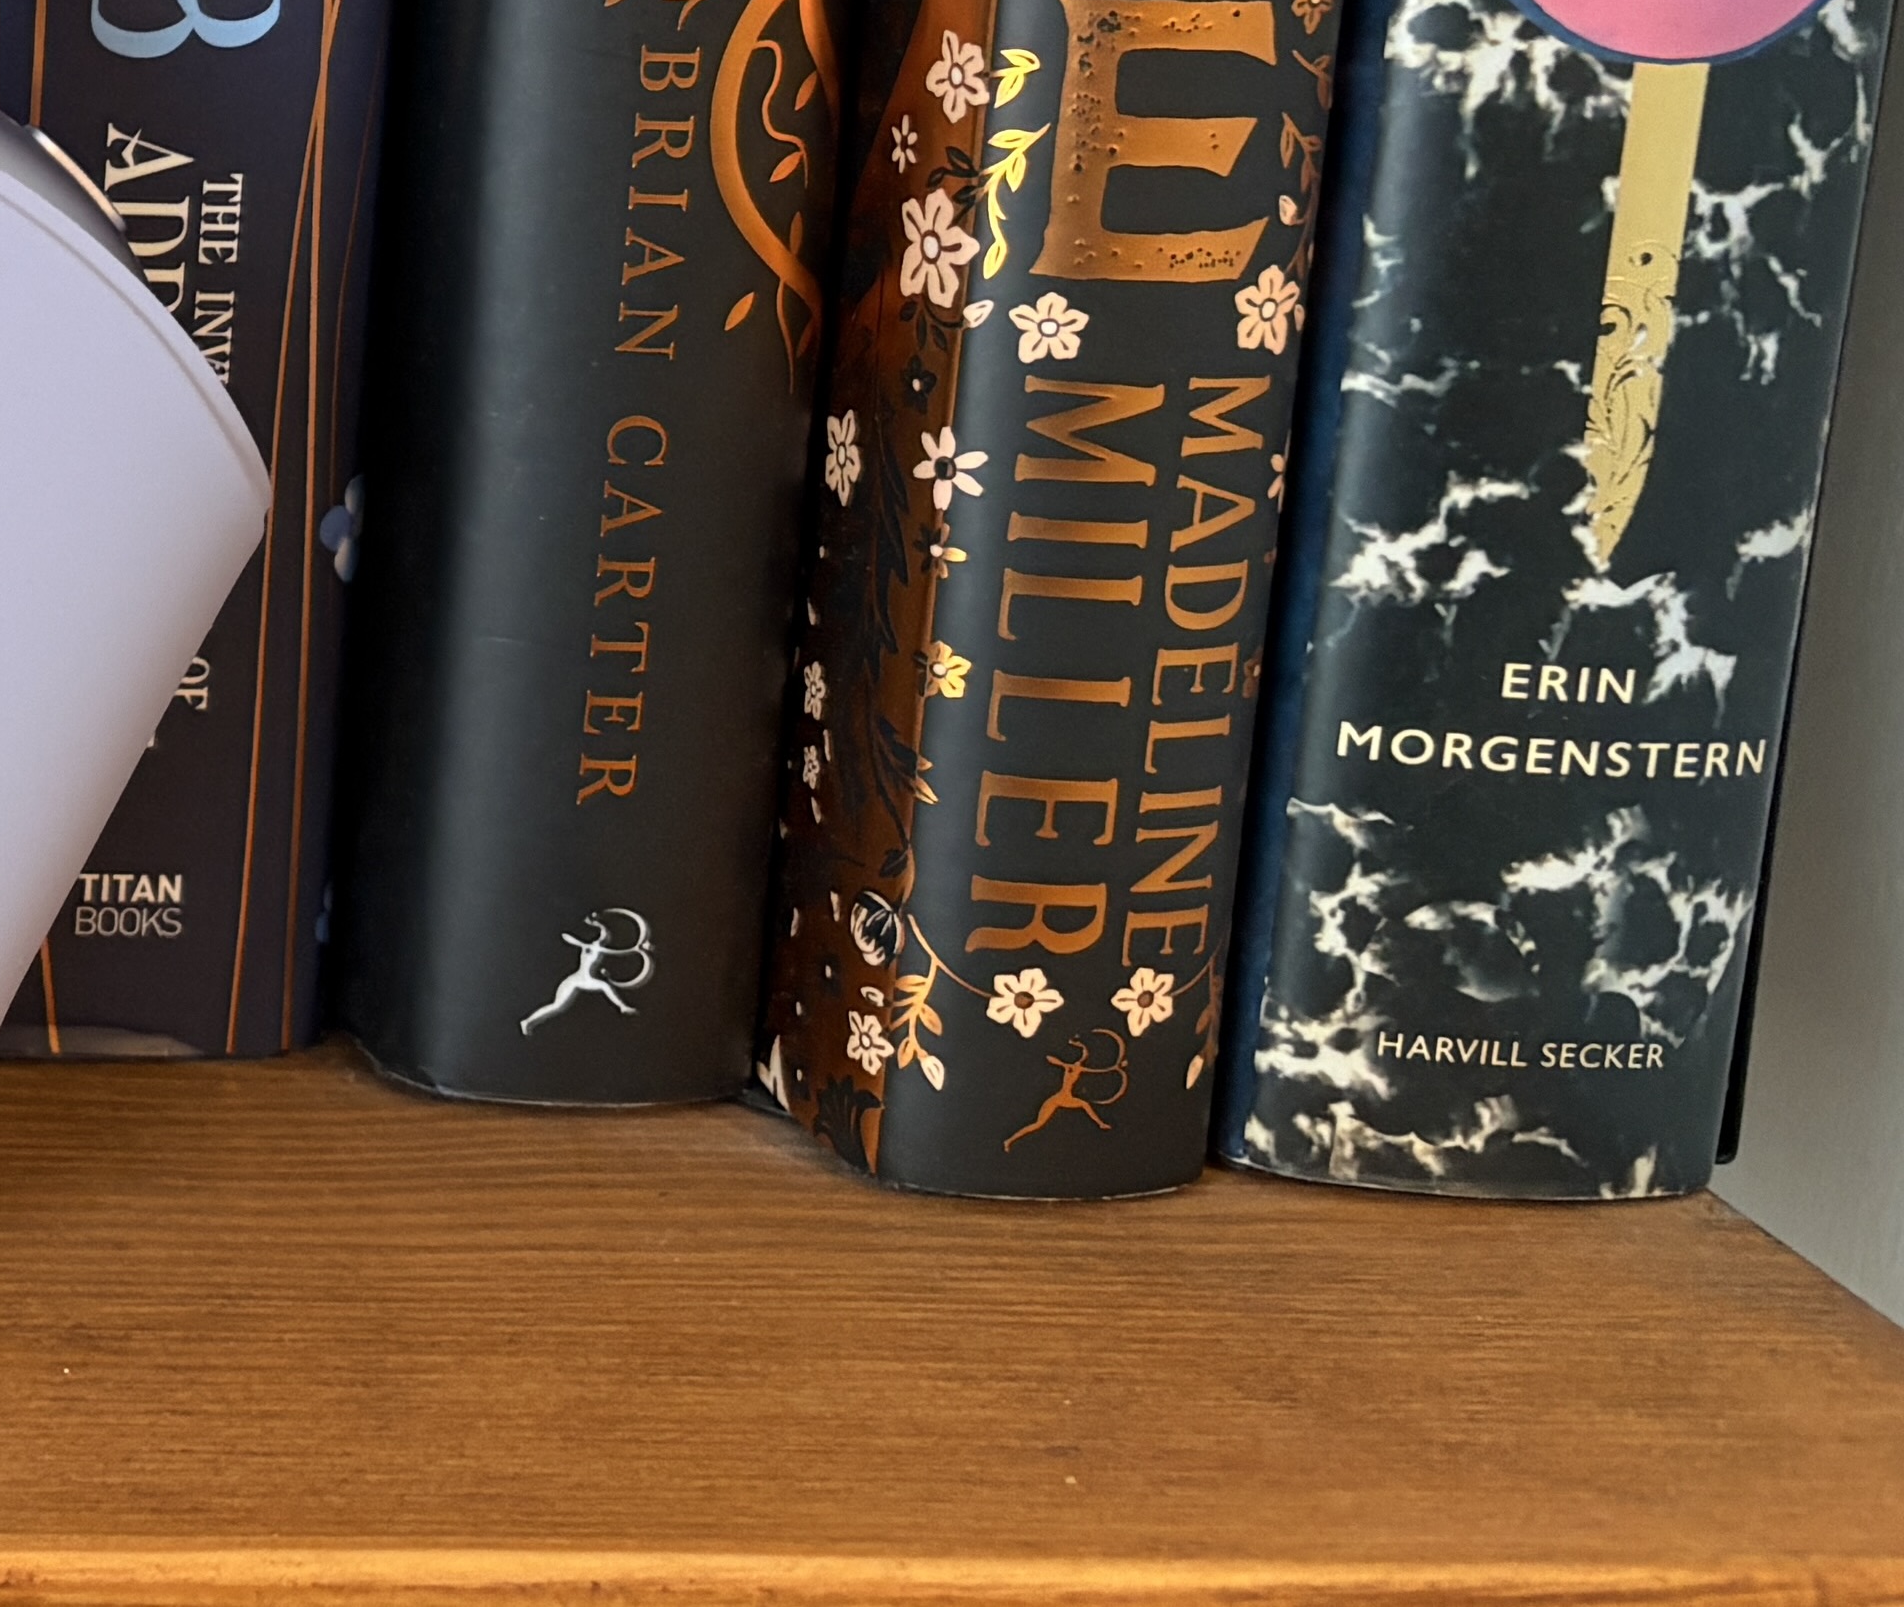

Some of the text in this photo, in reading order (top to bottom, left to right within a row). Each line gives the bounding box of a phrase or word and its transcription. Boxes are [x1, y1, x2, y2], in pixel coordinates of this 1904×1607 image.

[198, 173, 243, 264] THE
[576, 44, 701, 805] BRIAN CARTER
[963, 374, 1167, 956] MILLER
[1121, 375, 1273, 969] MADELINE
[1501, 662, 1636, 705] ERIN
[1336, 721, 1767, 779] MORGENSTERN
[79, 873, 182, 903] TITAN
[75, 906, 183, 938] BOOKS
[1376, 1031, 1665, 1070] HARVILL SECKER
